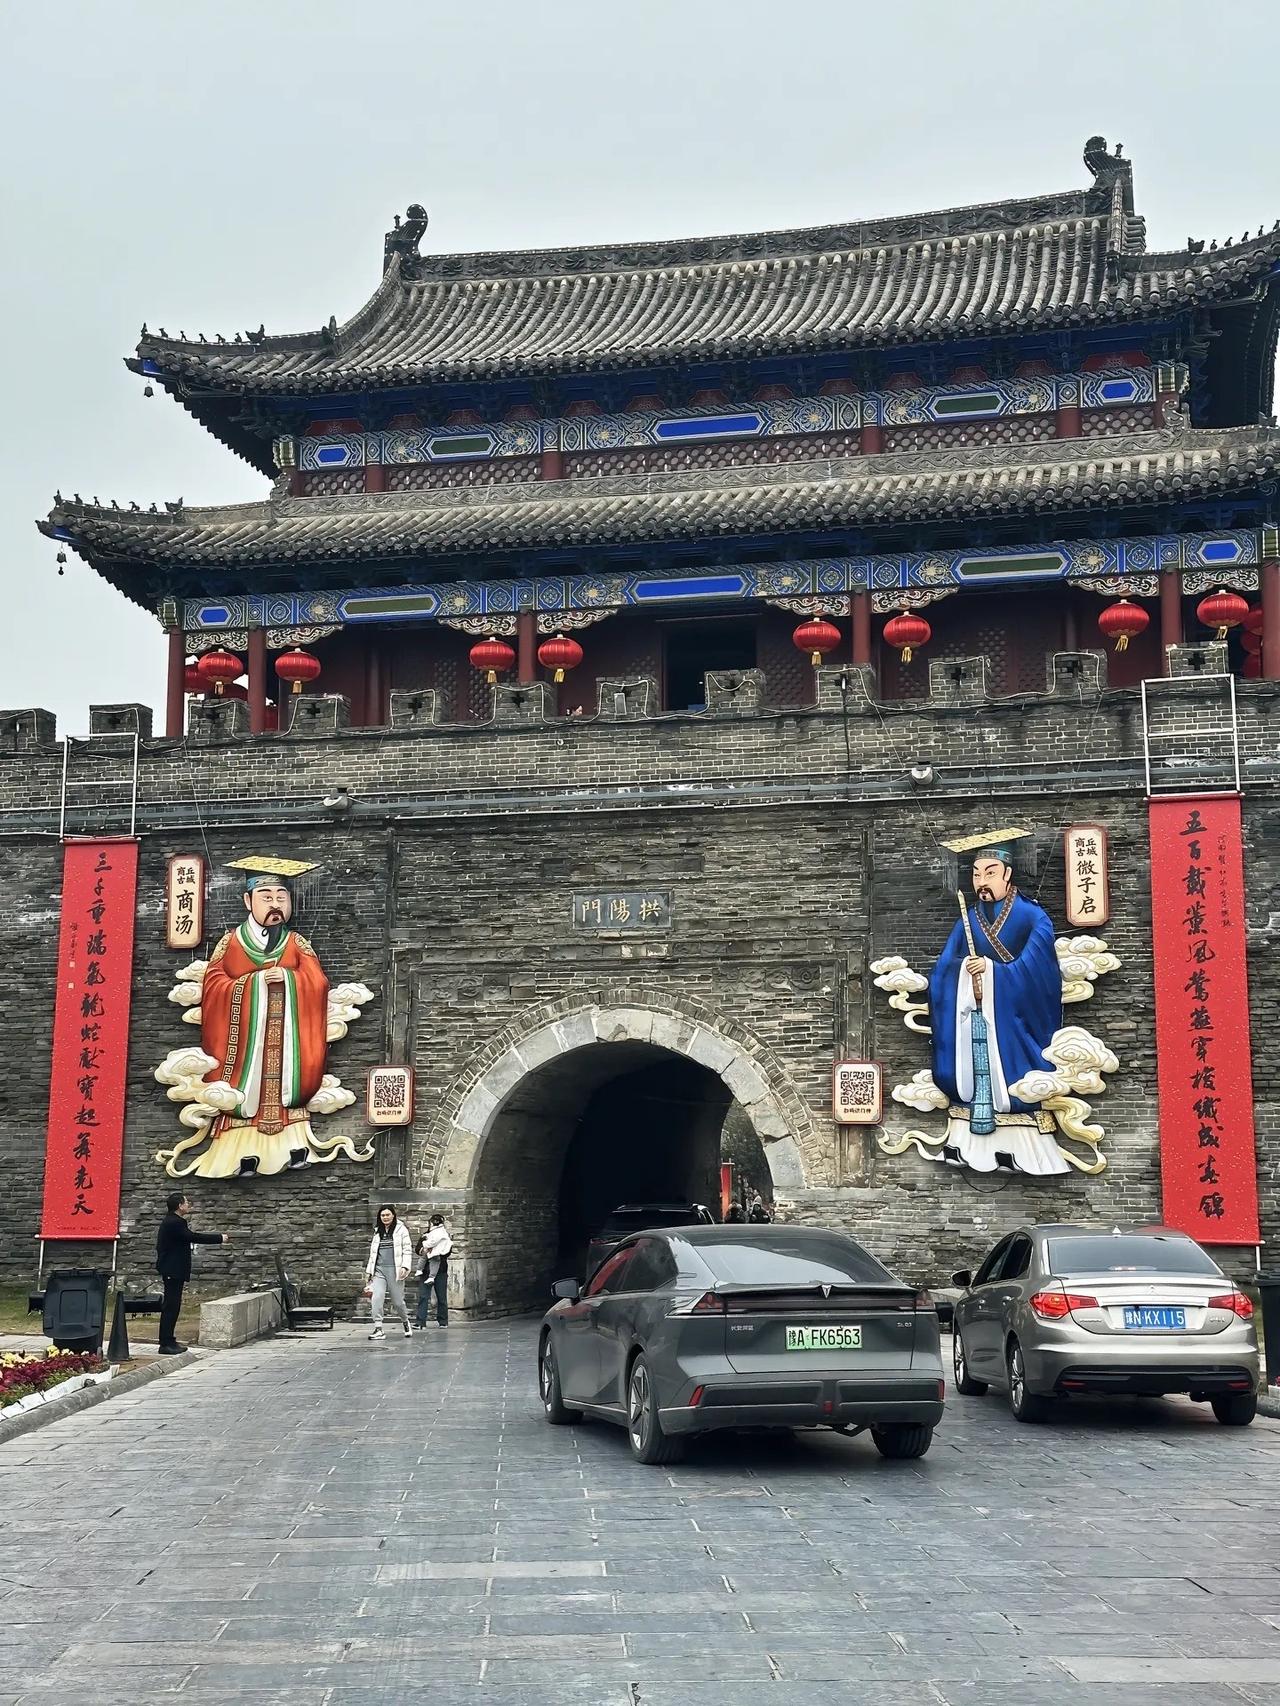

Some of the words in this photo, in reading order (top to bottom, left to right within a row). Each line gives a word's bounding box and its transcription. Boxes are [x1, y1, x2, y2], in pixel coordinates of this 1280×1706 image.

[175, 889, 195, 935] 商汤
[1076, 860, 1099, 915] 微子启
